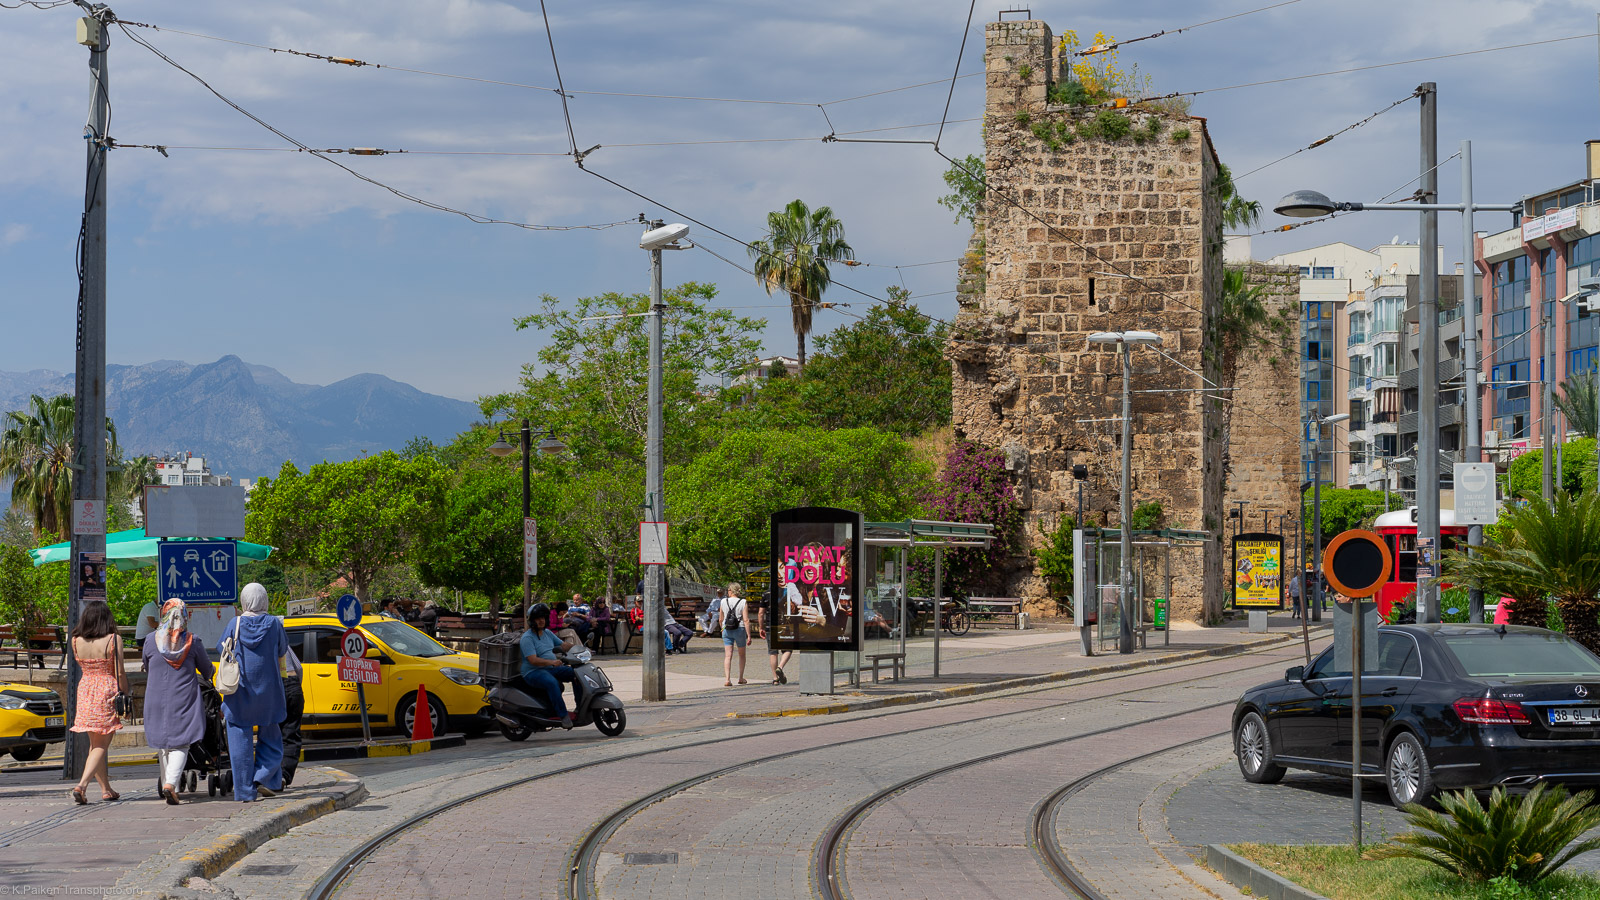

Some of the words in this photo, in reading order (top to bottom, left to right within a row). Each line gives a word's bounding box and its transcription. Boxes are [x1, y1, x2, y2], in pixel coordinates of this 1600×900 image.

[784, 546, 845, 562] HAYAT
[784, 565, 846, 585] DOLU
[784, 586, 846, 618] LAV
[347, 637, 362, 654] 20
[345, 659, 373, 671] OTOPARK
[343, 668, 379, 684] DEĞİLDİR
[331, 703, 344, 711] 07
[350, 703, 373, 711] 072
[1554, 709, 1568, 721] 38
[1572, 709, 1586, 720] GL
